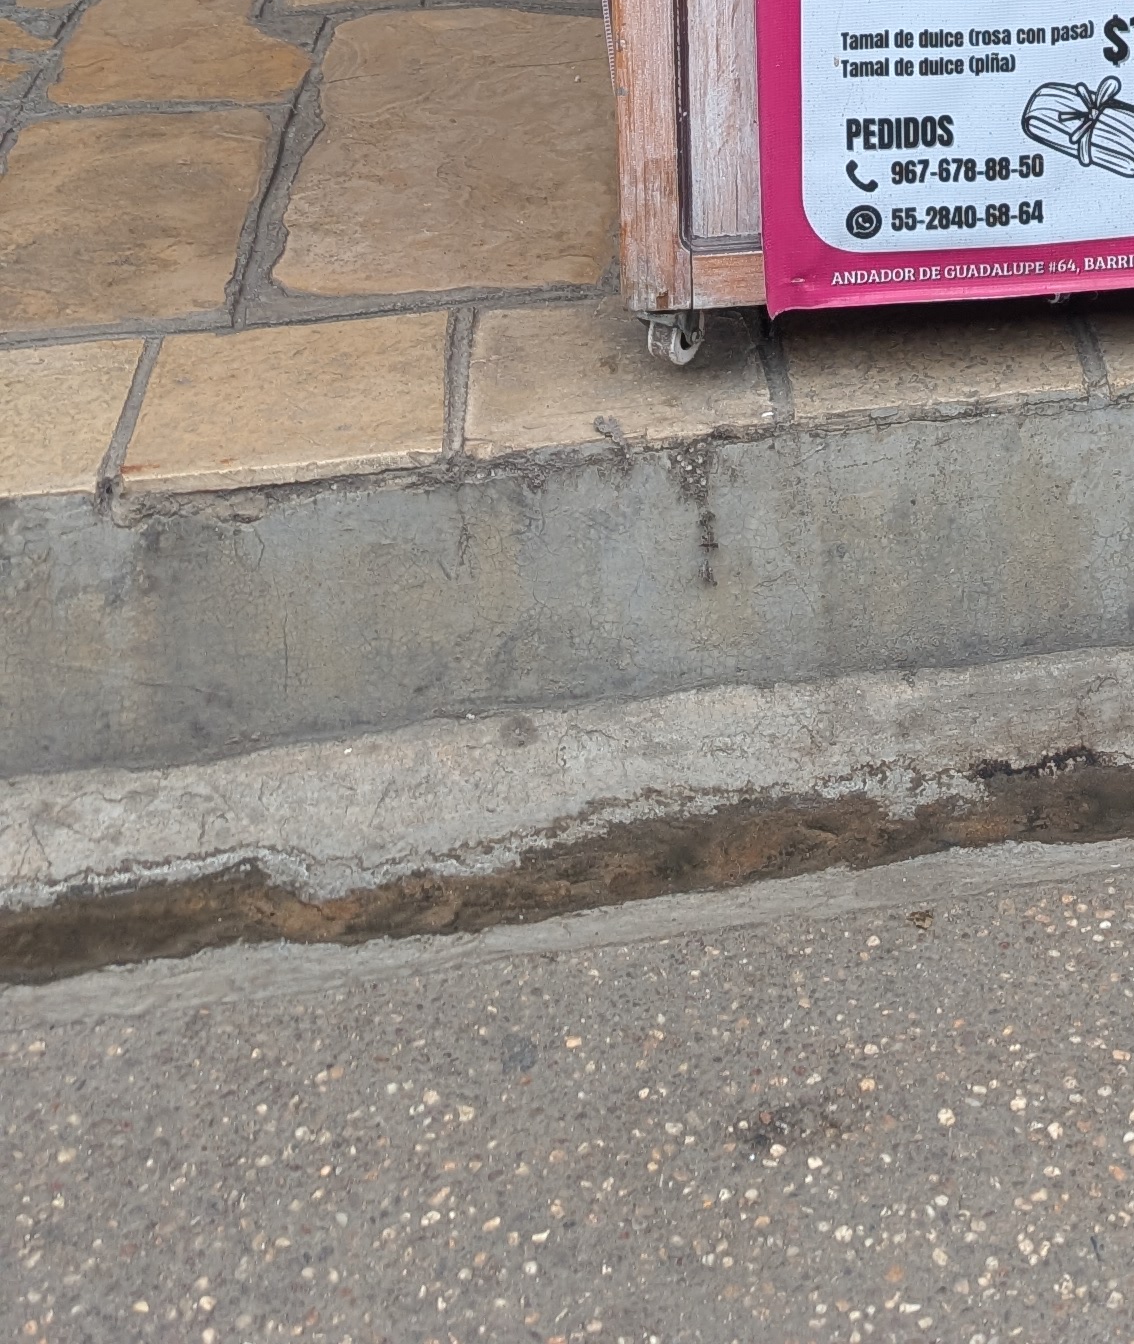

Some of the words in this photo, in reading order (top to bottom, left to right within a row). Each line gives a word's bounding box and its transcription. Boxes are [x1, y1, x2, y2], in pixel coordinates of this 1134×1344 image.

[841, 30, 889, 50] Tamal
[895, 30, 913, 48] de
[919, 29, 963, 48] dulce
[969, 29, 1011, 46] (rosa
[1017, 28, 1045, 44] con
[1051, 21, 1094, 45] pasa)
[847, 115, 953, 150] PEDIDOS
[891, 154, 1043, 184] 967-678-88-50
[891, 200, 1043, 231] 55-2840-68-64
[832, 268, 914, 284] ANDADOR
[920, 267, 940, 279] DE
[945, 262, 1043, 278] GUADALUPE
[1049, 260, 1079, 272] #64,
